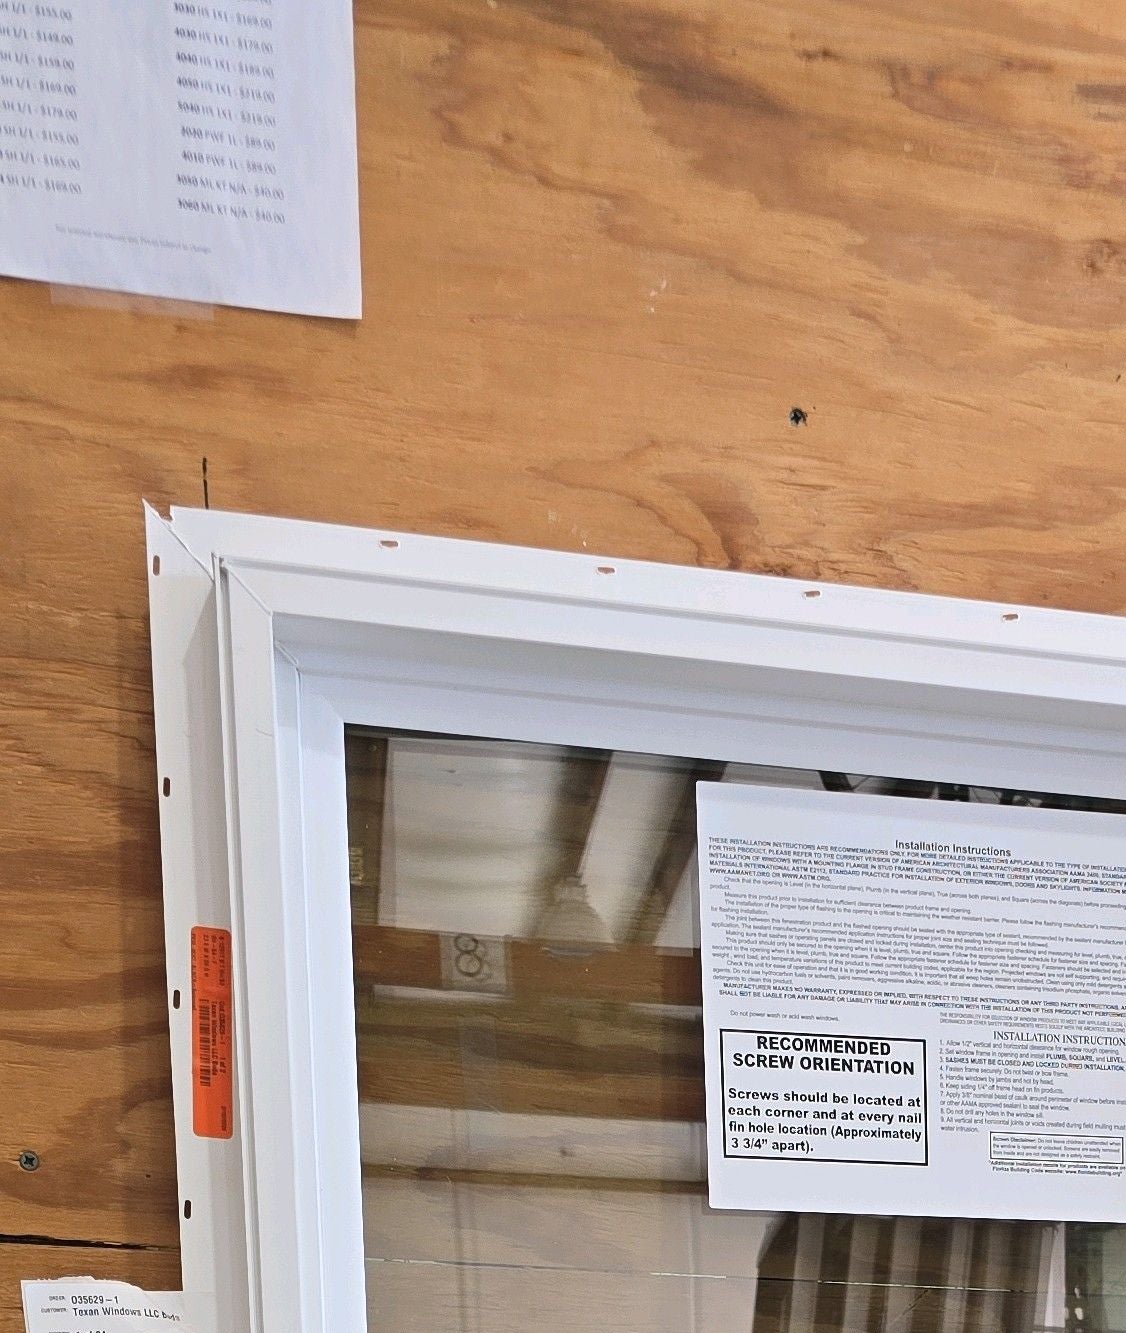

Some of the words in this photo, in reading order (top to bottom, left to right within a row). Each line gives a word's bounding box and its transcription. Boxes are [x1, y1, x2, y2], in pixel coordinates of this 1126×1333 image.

[895, 839, 950, 853] Installation
[952, 844, 1012, 857] Instructions
[756, 1035, 891, 1056] RECOMMENDED
[993, 1030, 1060, 1044] INSTALLATION
[733, 1053, 795, 1069] SCREW
[799, 1056, 915, 1076] ORIENTATION
[728, 1087, 779, 1101] Screws
[783, 1090, 828, 1104] should
[833, 1092, 849, 1105] be
[853, 1094, 903, 1107] located
[907, 1096, 921, 1108] at
[728, 1105, 761, 1117] each
[765, 1109, 809, 1120] corner
[812, 1109, 837, 1120] and
[840, 1110, 855, 1121] at
[858, 1112, 894, 1125] every
[898, 1112, 922, 1124] nail
[728, 1121, 745, 1132] fin
[748, 1122, 774, 1134] hole
[778, 1124, 827, 1136] location
[831, 1125, 922, 1143] (Approximately
[731, 1137, 739, 1149] 3
[772, 1140, 814, 1155] apart).
[72, 1308, 99, 1317] Texan
[101, 1307, 142, 1317] Windows
[144, 1308, 160, 1318] LLC
